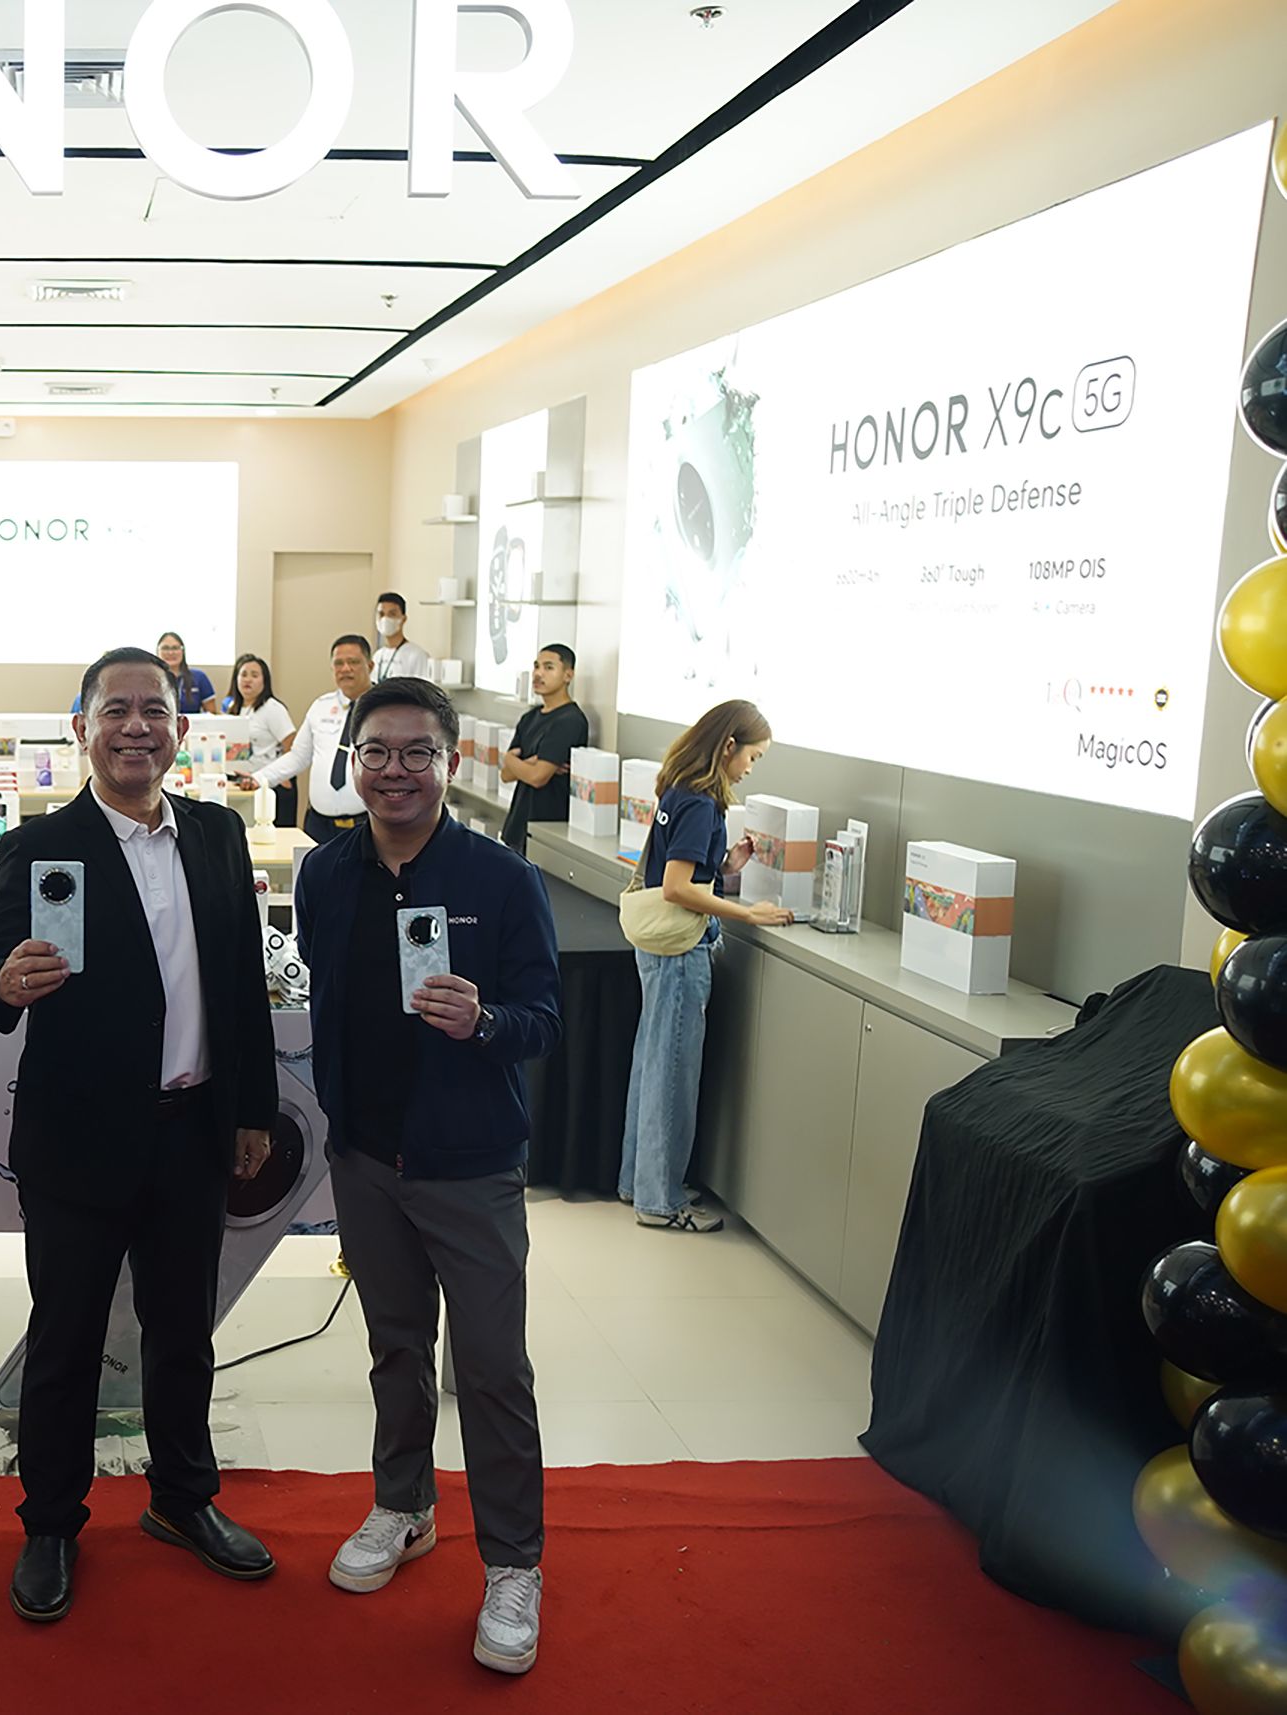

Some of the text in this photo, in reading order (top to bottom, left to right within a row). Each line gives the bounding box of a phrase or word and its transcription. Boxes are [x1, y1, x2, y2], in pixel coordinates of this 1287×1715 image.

[829, 372, 1123, 475] HONOR X9c 5G
[851, 479, 1083, 529] All-Angle Triple Defense
[948, 563, 985, 587] Tough
[1029, 557, 1106, 580] 108MP OIS
[1077, 733, 1168, 769] MagicOS
[448, 916, 478, 925] HONOR
